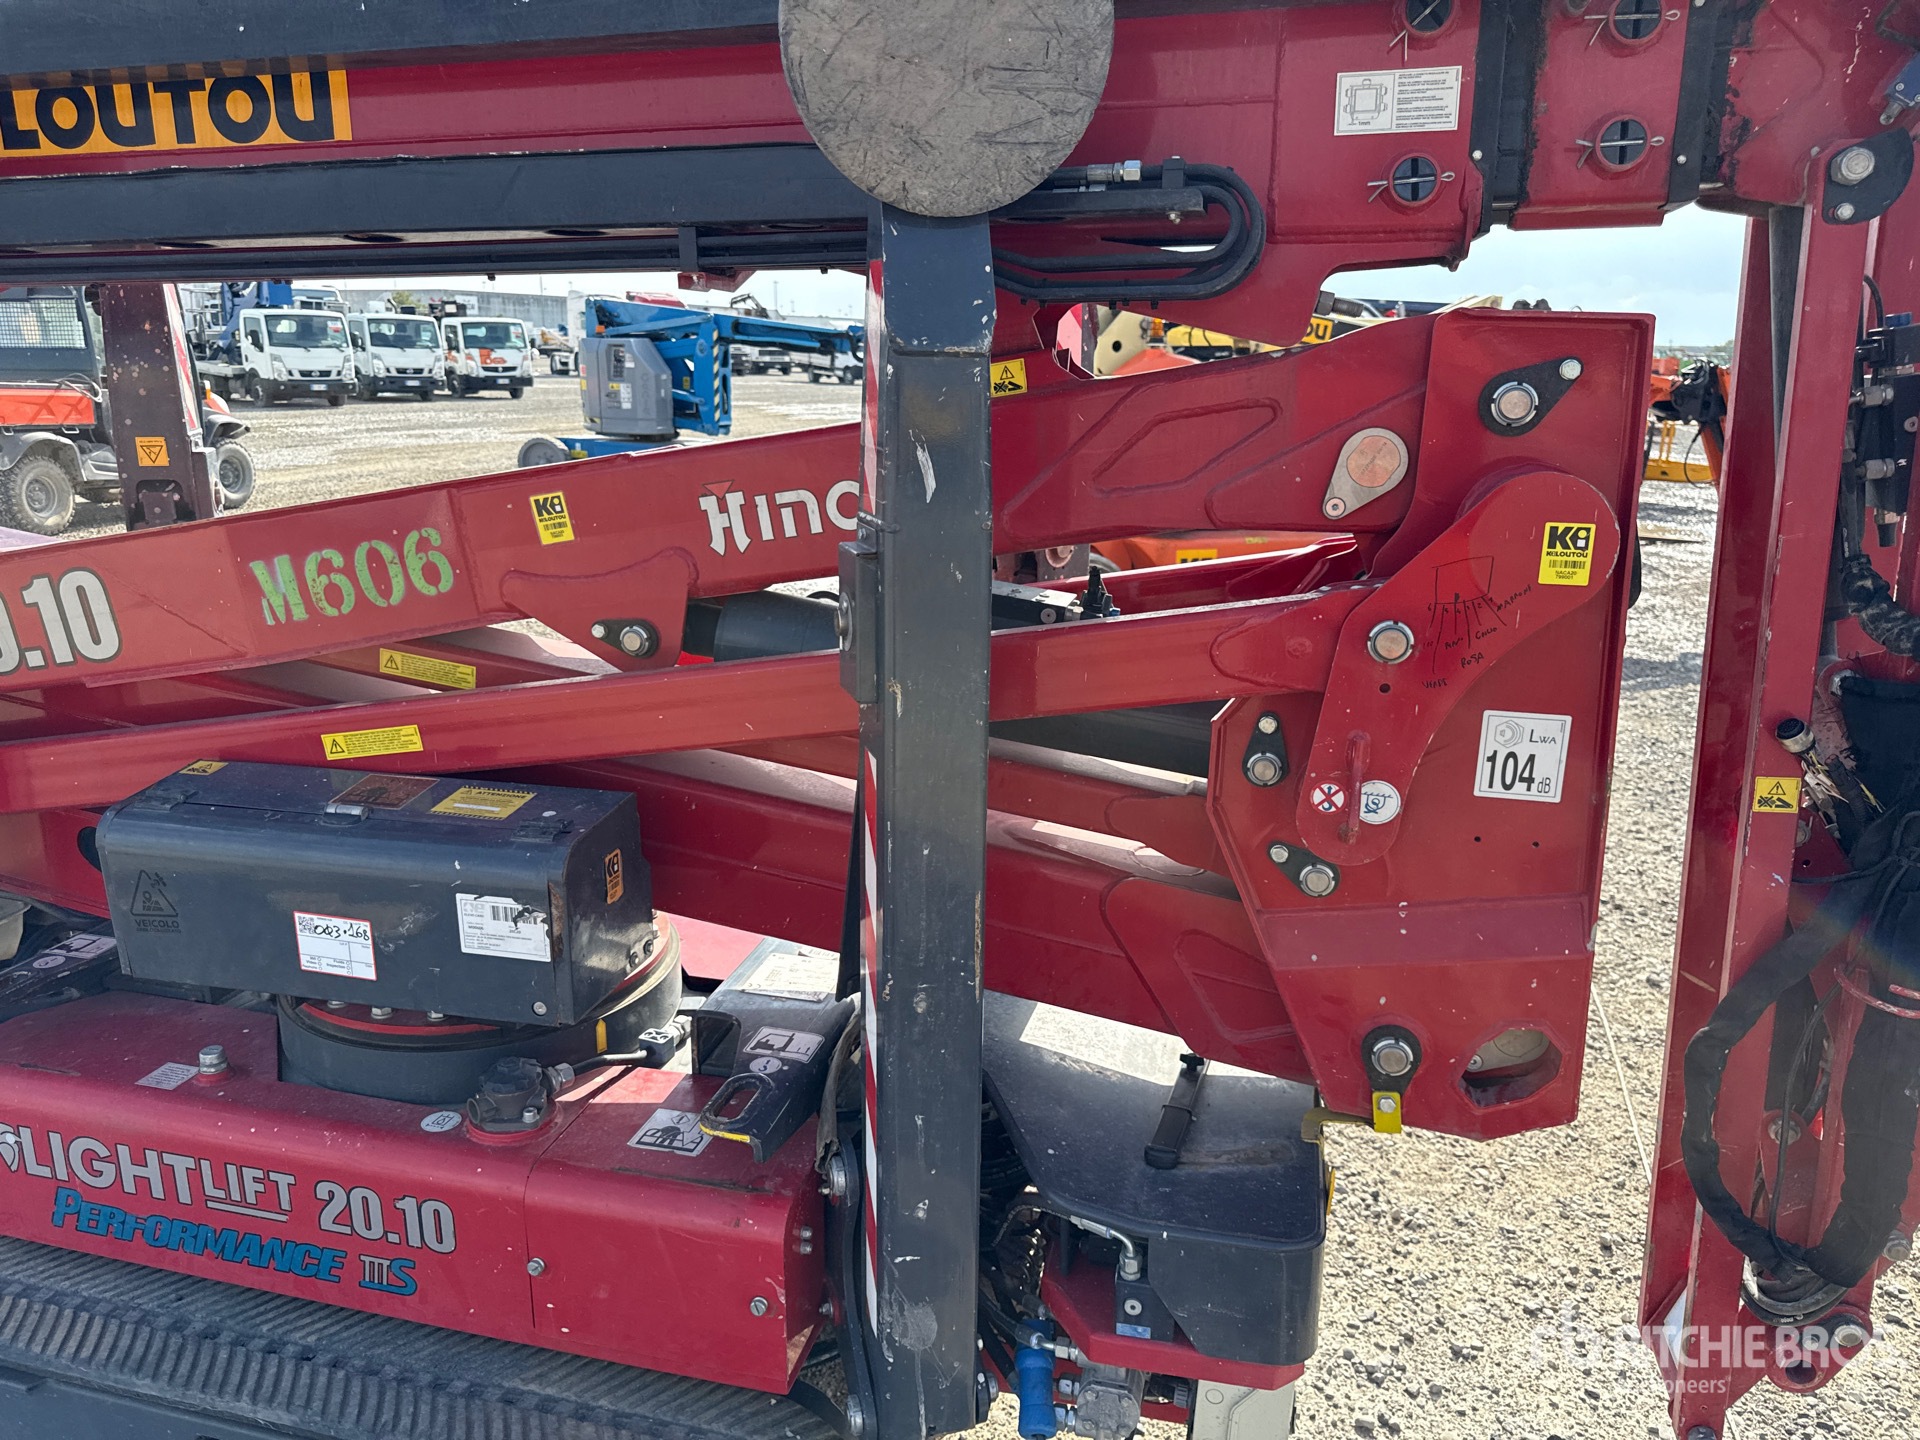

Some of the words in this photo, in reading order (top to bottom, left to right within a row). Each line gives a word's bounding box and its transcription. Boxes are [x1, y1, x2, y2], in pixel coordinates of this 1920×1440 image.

[250, 528, 454, 635] M606
[475, 790, 527, 799] ATTENZIONE
[1486, 750, 1536, 791] 104
[1537, 777, 1552, 793] dB
[135, 919, 179, 928] VEICOLO
[51, 1186, 347, 1283] PERFORMANCE
[314, 1180, 457, 1254] 20.10
